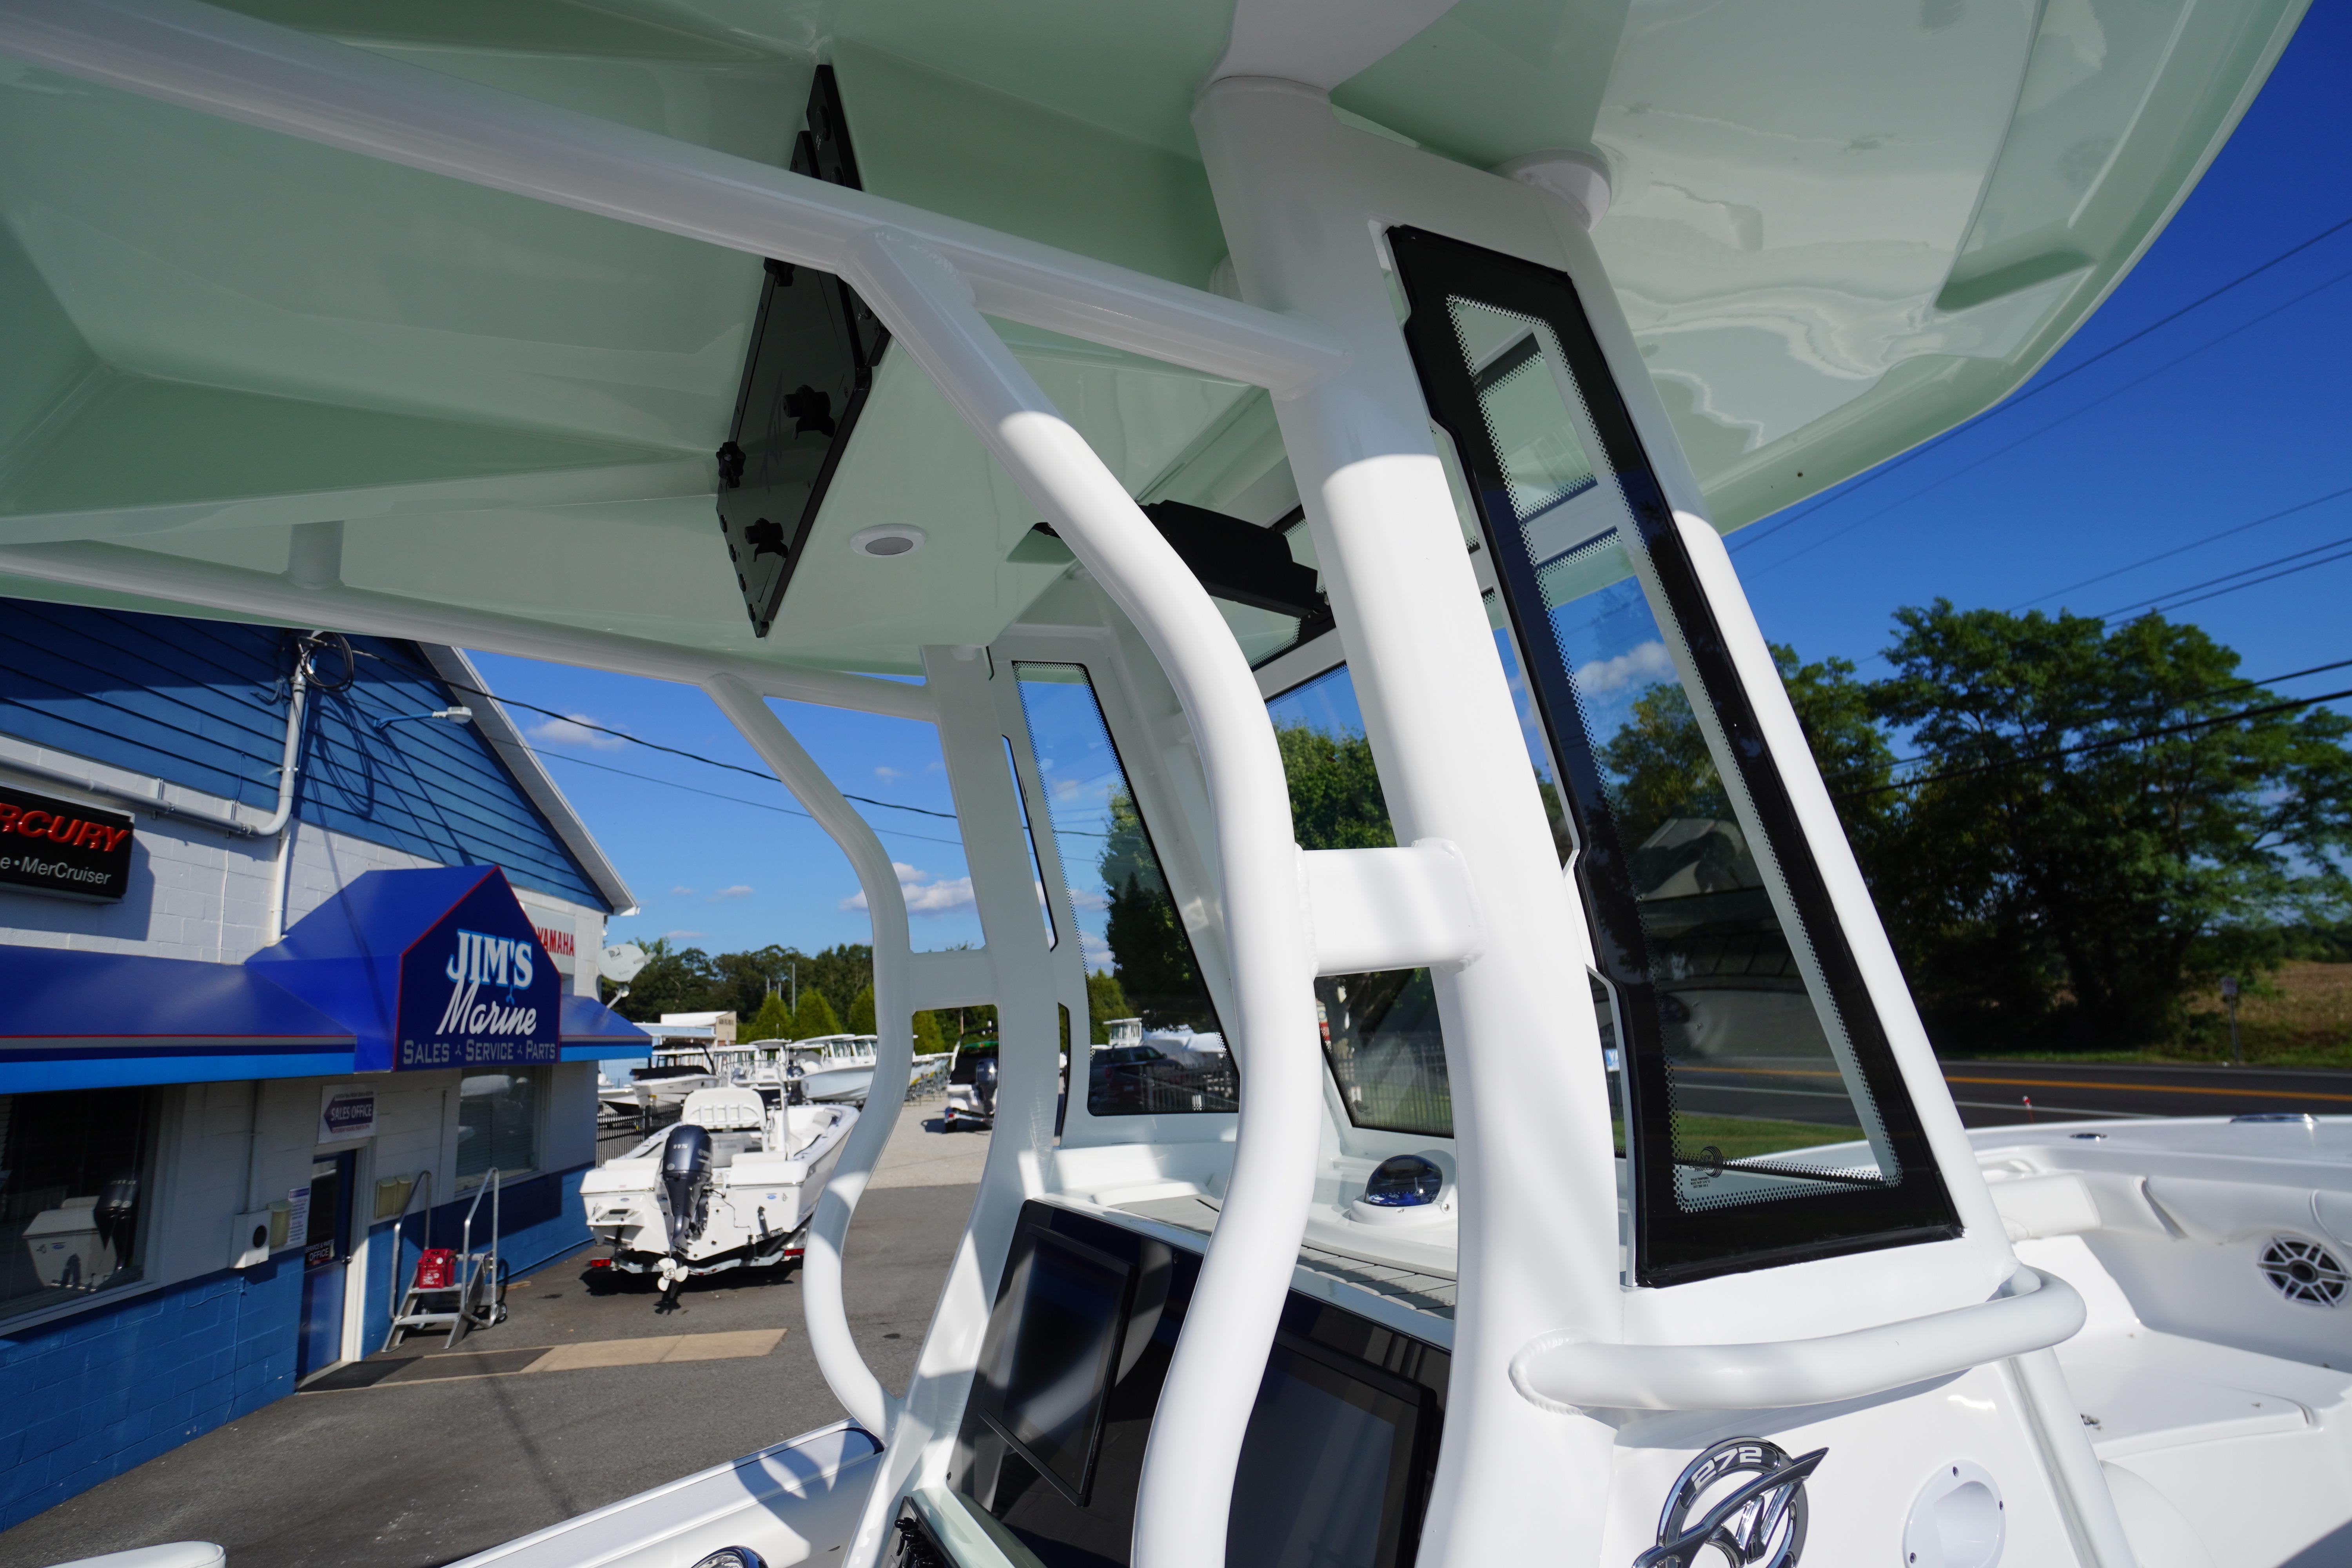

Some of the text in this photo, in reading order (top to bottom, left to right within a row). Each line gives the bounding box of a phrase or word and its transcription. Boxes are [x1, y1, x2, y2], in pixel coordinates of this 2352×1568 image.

[21, 856, 112, 884] MerCruiser
[446, 928, 533, 990] JIM'S
[436, 979, 537, 1035] Marine
[403, 1038, 556, 1064] SALES SERVICE PARTS
[331, 1103, 372, 1121] SALES OFFICE
[309, 1247, 329, 1261] OFFICE
[1691, 1446, 1762, 1491] 272
